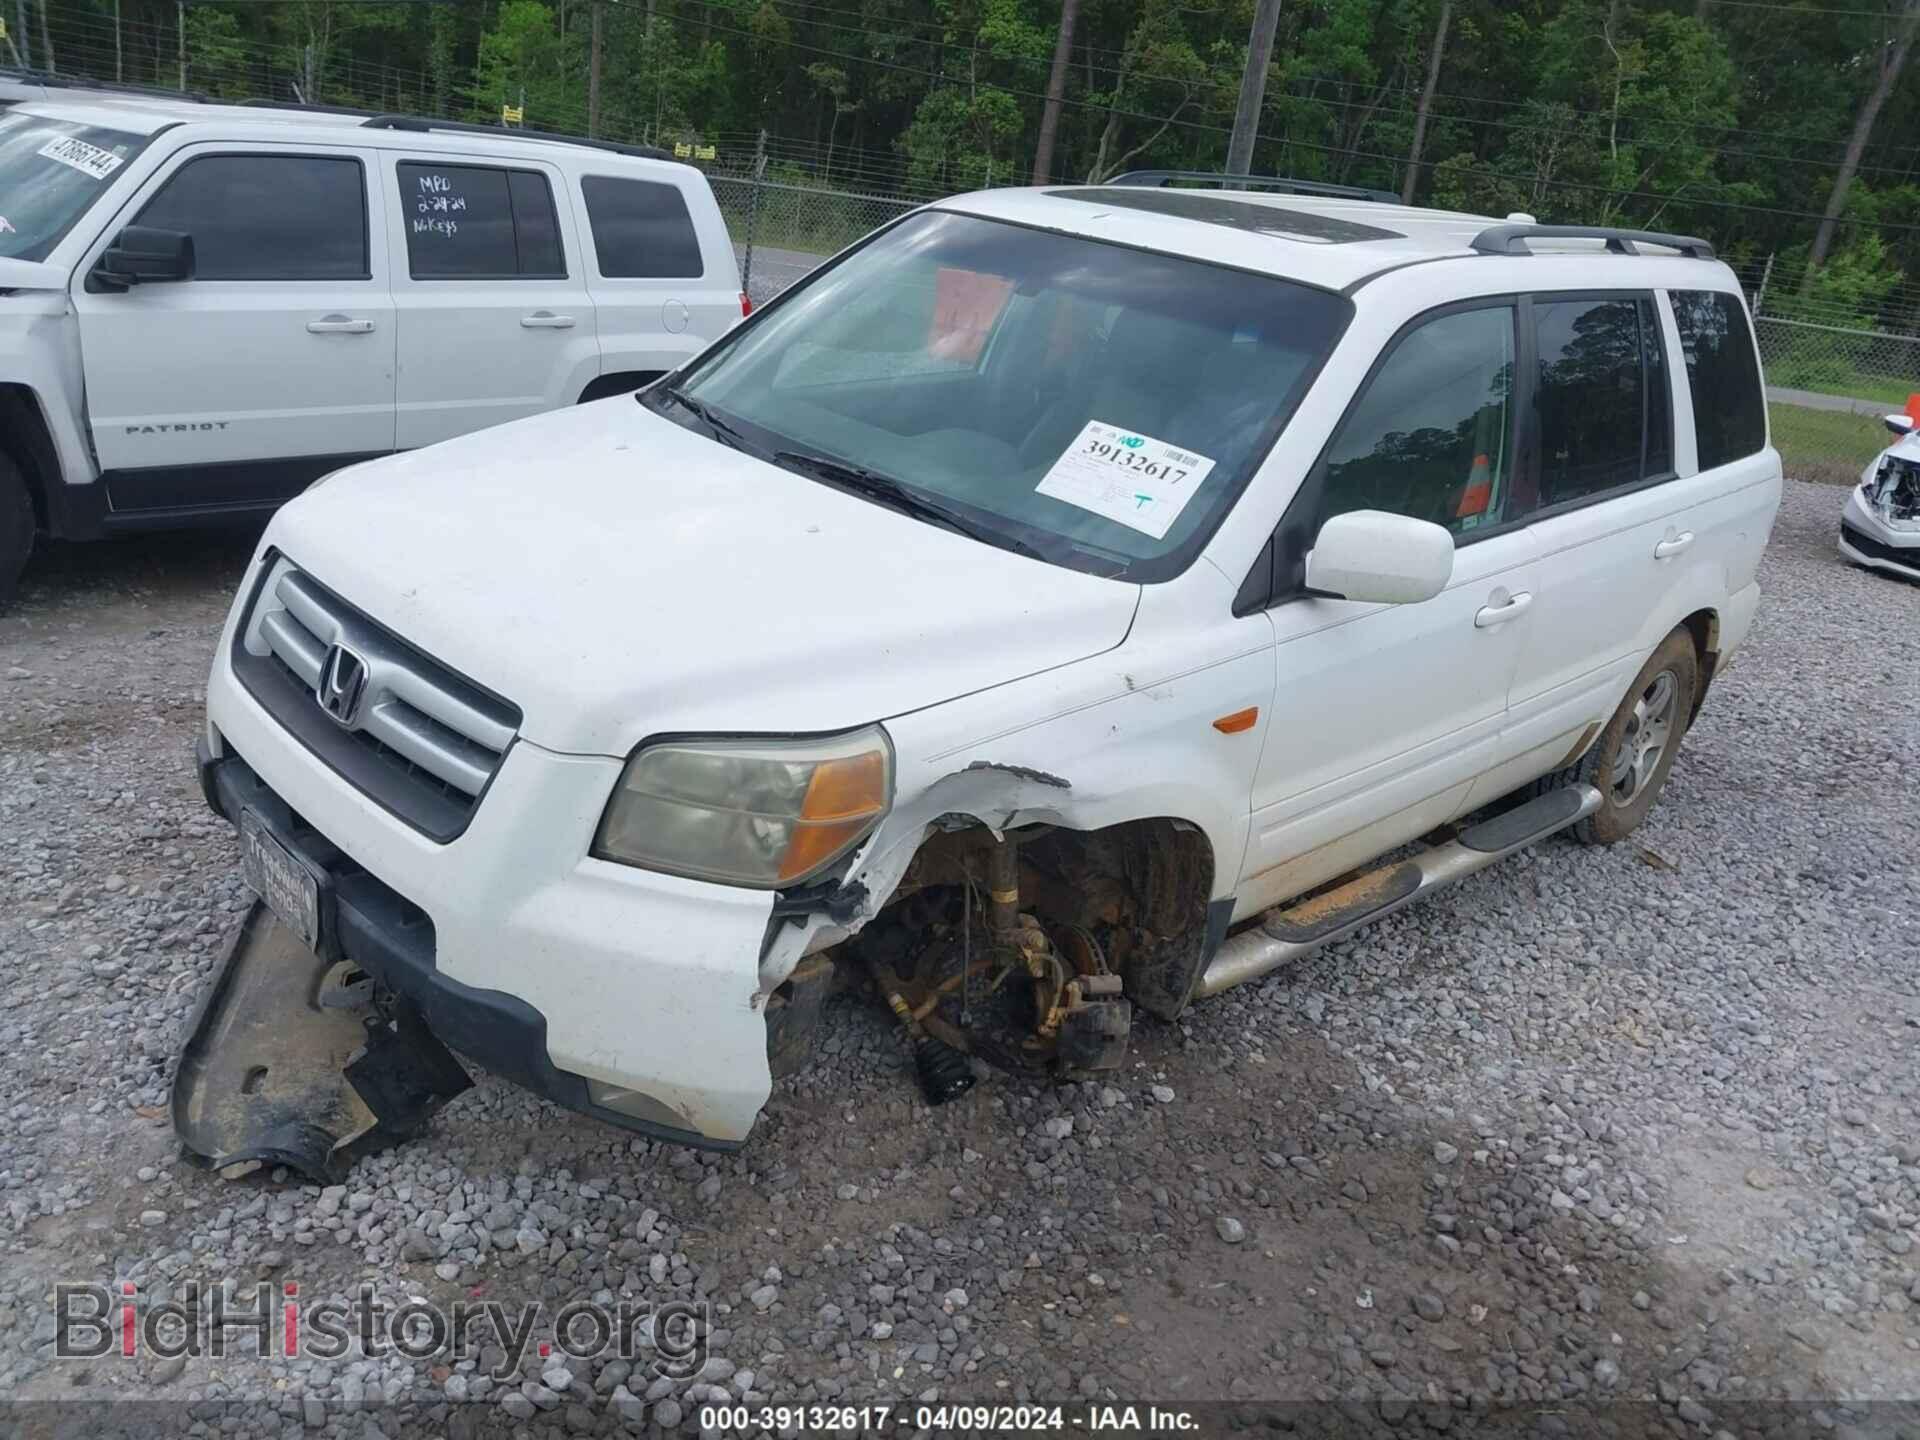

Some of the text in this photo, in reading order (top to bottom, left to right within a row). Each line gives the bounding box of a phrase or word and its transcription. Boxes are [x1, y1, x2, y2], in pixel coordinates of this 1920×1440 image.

[126, 422, 230, 434] PATRIOT
[1082, 440, 1187, 485] 39132617
[1134, 494, 1153, 510] T
